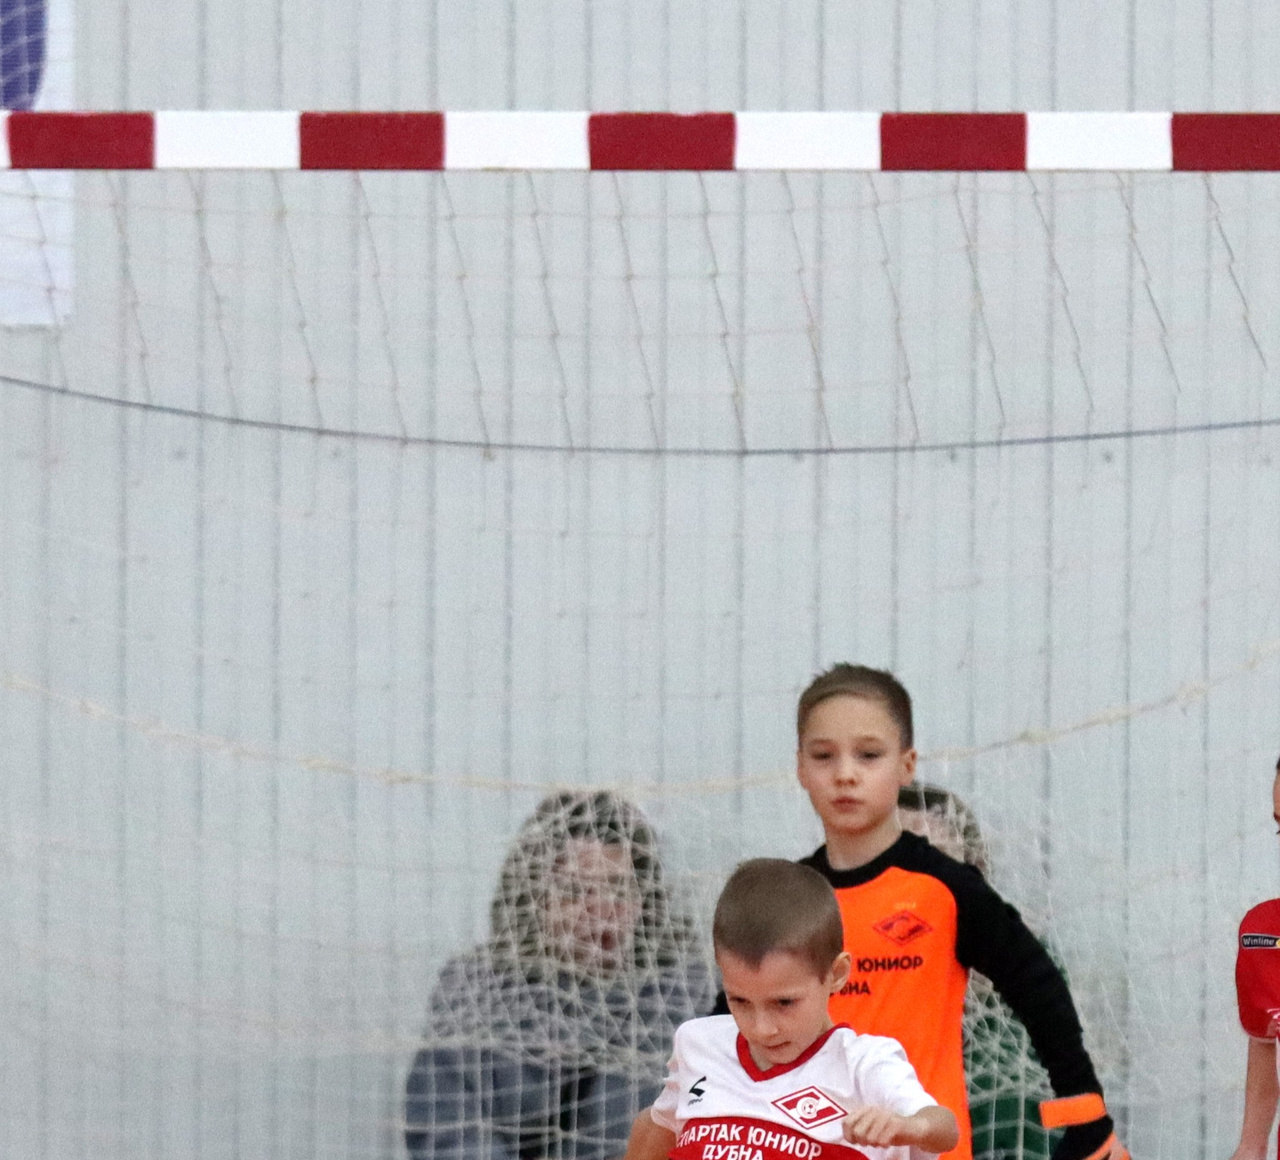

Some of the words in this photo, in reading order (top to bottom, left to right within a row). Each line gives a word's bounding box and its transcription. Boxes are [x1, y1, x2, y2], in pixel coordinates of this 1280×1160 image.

[1242, 936, 1276, 947] Winline
[856, 955, 924, 973] ЮНИОР
[829, 980, 871, 997] БНА
[747, 1126, 822, 1160] ЮНИОР
